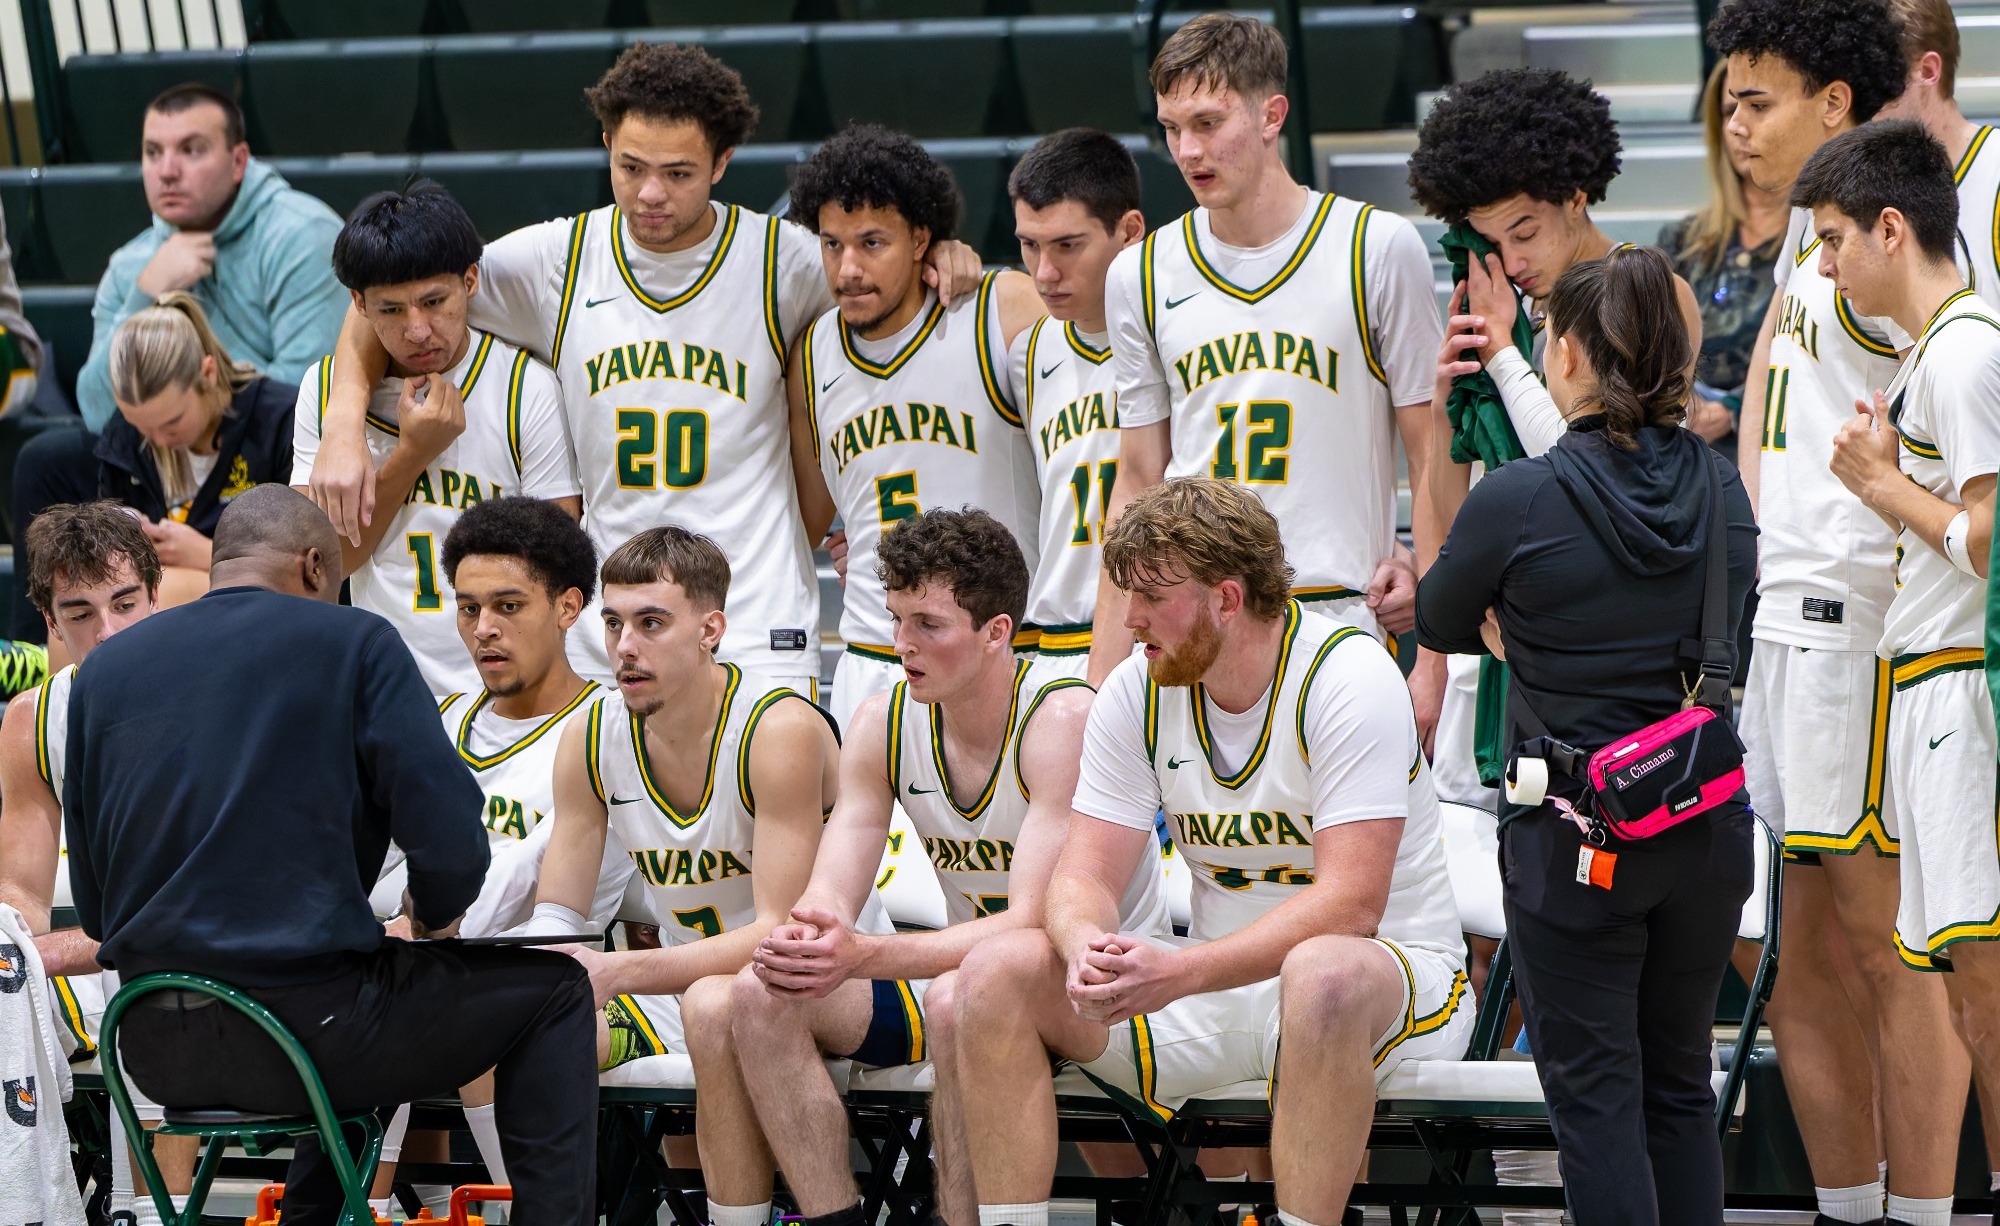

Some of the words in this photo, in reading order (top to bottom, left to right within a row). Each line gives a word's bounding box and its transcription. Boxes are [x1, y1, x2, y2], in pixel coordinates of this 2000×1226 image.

[584, 339, 748, 403] YAVAPAI
[1174, 330, 1340, 395] YAVAPAI
[615, 407, 710, 491] 20
[829, 402, 979, 476] YAVAPAI
[1209, 399, 1294, 485] 12
[874, 469, 922, 538] 5
[406, 532, 444, 613] 1
[1616, 776, 1630, 789] A.
[1629, 748, 1675, 779] Cinnamo
